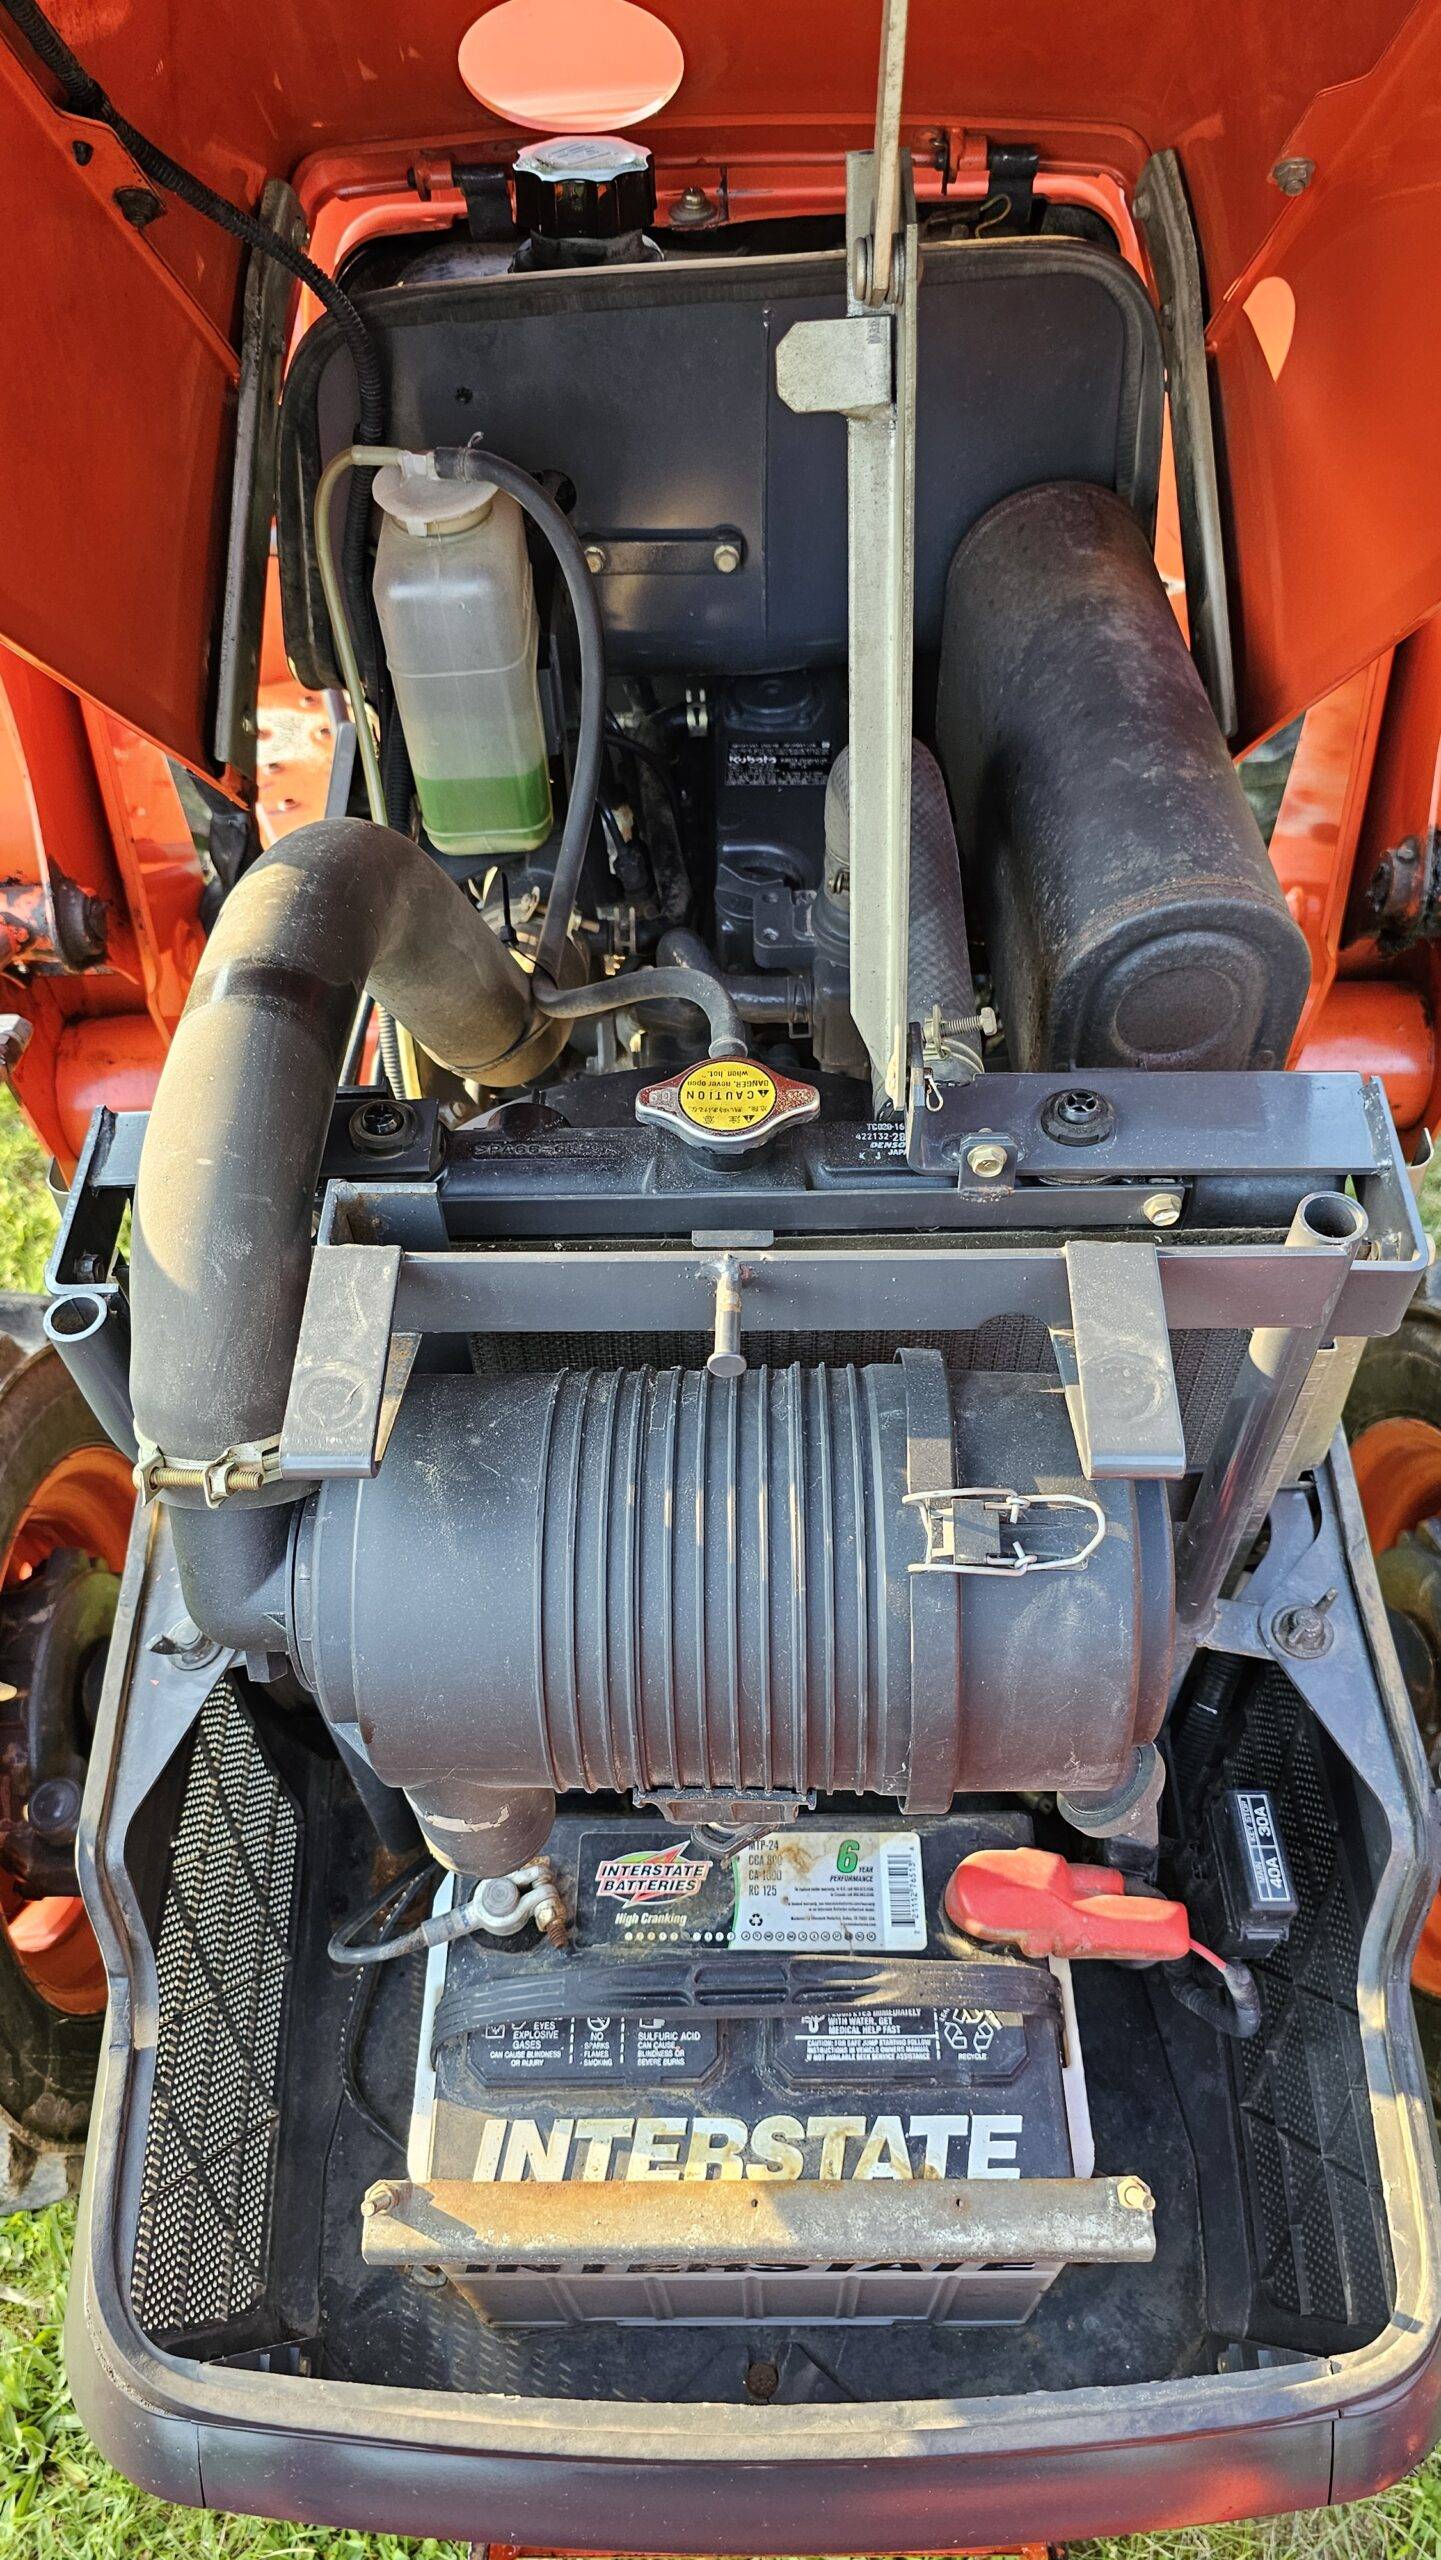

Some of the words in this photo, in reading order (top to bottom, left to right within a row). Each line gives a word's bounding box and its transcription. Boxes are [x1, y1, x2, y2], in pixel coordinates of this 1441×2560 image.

[686, 1090, 754, 1100] CAUTION
[1254, 1806, 1271, 1837] 30A
[749, 1840, 779, 1851] MTP-24
[749, 1855, 764, 1866] CCA
[837, 1839, 860, 1873] 6
[602, 1864, 705, 1877] INTERSTATE
[749, 1870, 760, 1881] CA
[1266, 1856, 1282, 1888] 40A
[604, 1880, 698, 1891] BATTERIES
[749, 1885, 760, 1896] RC
[763, 1885, 777, 1896] 125
[615, 1912, 639, 1927] High
[640, 1912, 688, 1929] Cranking
[533, 2021, 556, 2030] EYES
[828, 2017, 848, 2026] WITH
[878, 2016, 893, 2025] GET
[513, 2030, 559, 2039] EXPLOSIVE
[828, 2026, 861, 2034] MEDICAL
[862, 2025, 882, 2034] HELP
[883, 2025, 900, 2034] FAST
[590, 2032, 604, 2040] NO
[638, 2031, 678, 2040] SULFURIC
[680, 2031, 701, 2040] ACID
[512, 2040, 542, 2050] GASES
[638, 2041, 652, 2049] CAN
[526, 2050, 561, 2058] BLINDNESS
[583, 2050, 609, 2058] FLAMES
[637, 2050, 673, 2058] BLINDNESS
[674, 2049, 685, 2057] OR
[511, 2059, 520, 2067] OR
[522, 2059, 544, 2067] INJURY
[637, 2058, 662, 2066] SEVERE
[663, 2058, 685, 2066] BURNS
[472, 2114, 1024, 2182] INTERSTATE
